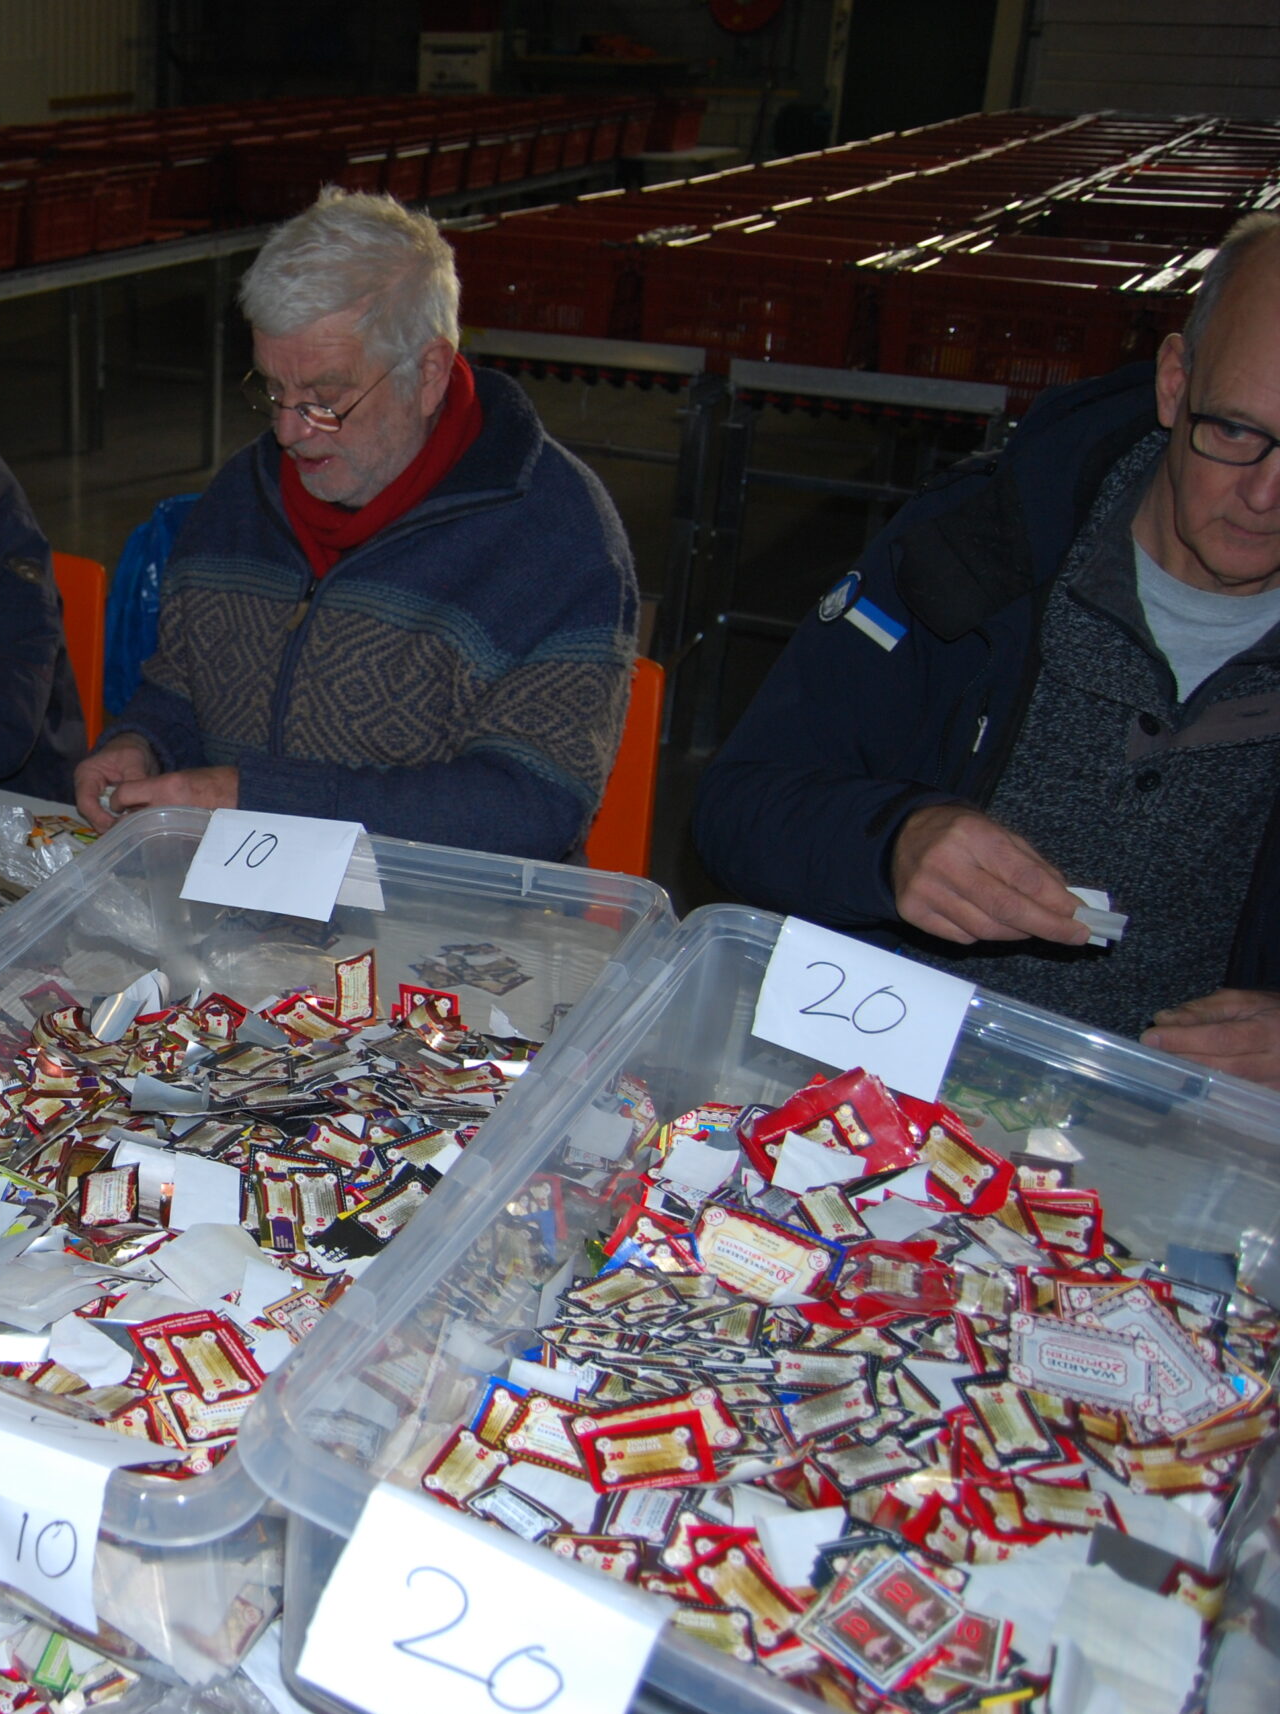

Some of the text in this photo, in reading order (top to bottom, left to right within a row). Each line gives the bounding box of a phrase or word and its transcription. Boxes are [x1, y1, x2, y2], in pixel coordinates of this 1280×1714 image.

[224, 830, 278, 868] 10
[799, 961, 907, 1034] 20
[293, 1012, 304, 1020] 10
[679, 1112, 694, 1124] 20
[322, 1136, 330, 1144] 10
[962, 1175, 976, 1188] 20
[1036, 1175, 1045, 1187] 20
[316, 1217, 326, 1226] 10
[375, 1216, 387, 1224] 10
[709, 1211, 722, 1221] 20
[832, 1223, 845, 1232] 20
[1065, 1230, 1081, 1238] 20
[776, 1270, 795, 1284] 20
[1075, 1289, 1088, 1303] 20
[1015, 1317, 1029, 1329] 20
[1047, 1358, 1116, 1380] WAARDE
[213, 1379, 225, 1389] 10
[696, 1392, 712, 1400] 20
[122, 1416, 133, 1427] 10
[191, 1427, 204, 1436] 10
[475, 1447, 489, 1461] 20
[607, 1451, 625, 1461] 20
[193, 1461, 207, 1471] 10
[941, 1527, 957, 1542] 20
[16, 1512, 78, 1578] 10
[601, 1557, 614, 1571] 20
[885, 1581, 913, 1604] 10
[843, 1617, 870, 1639] 10
[957, 1621, 982, 1640] 10
[392, 1566, 563, 1713] 20
